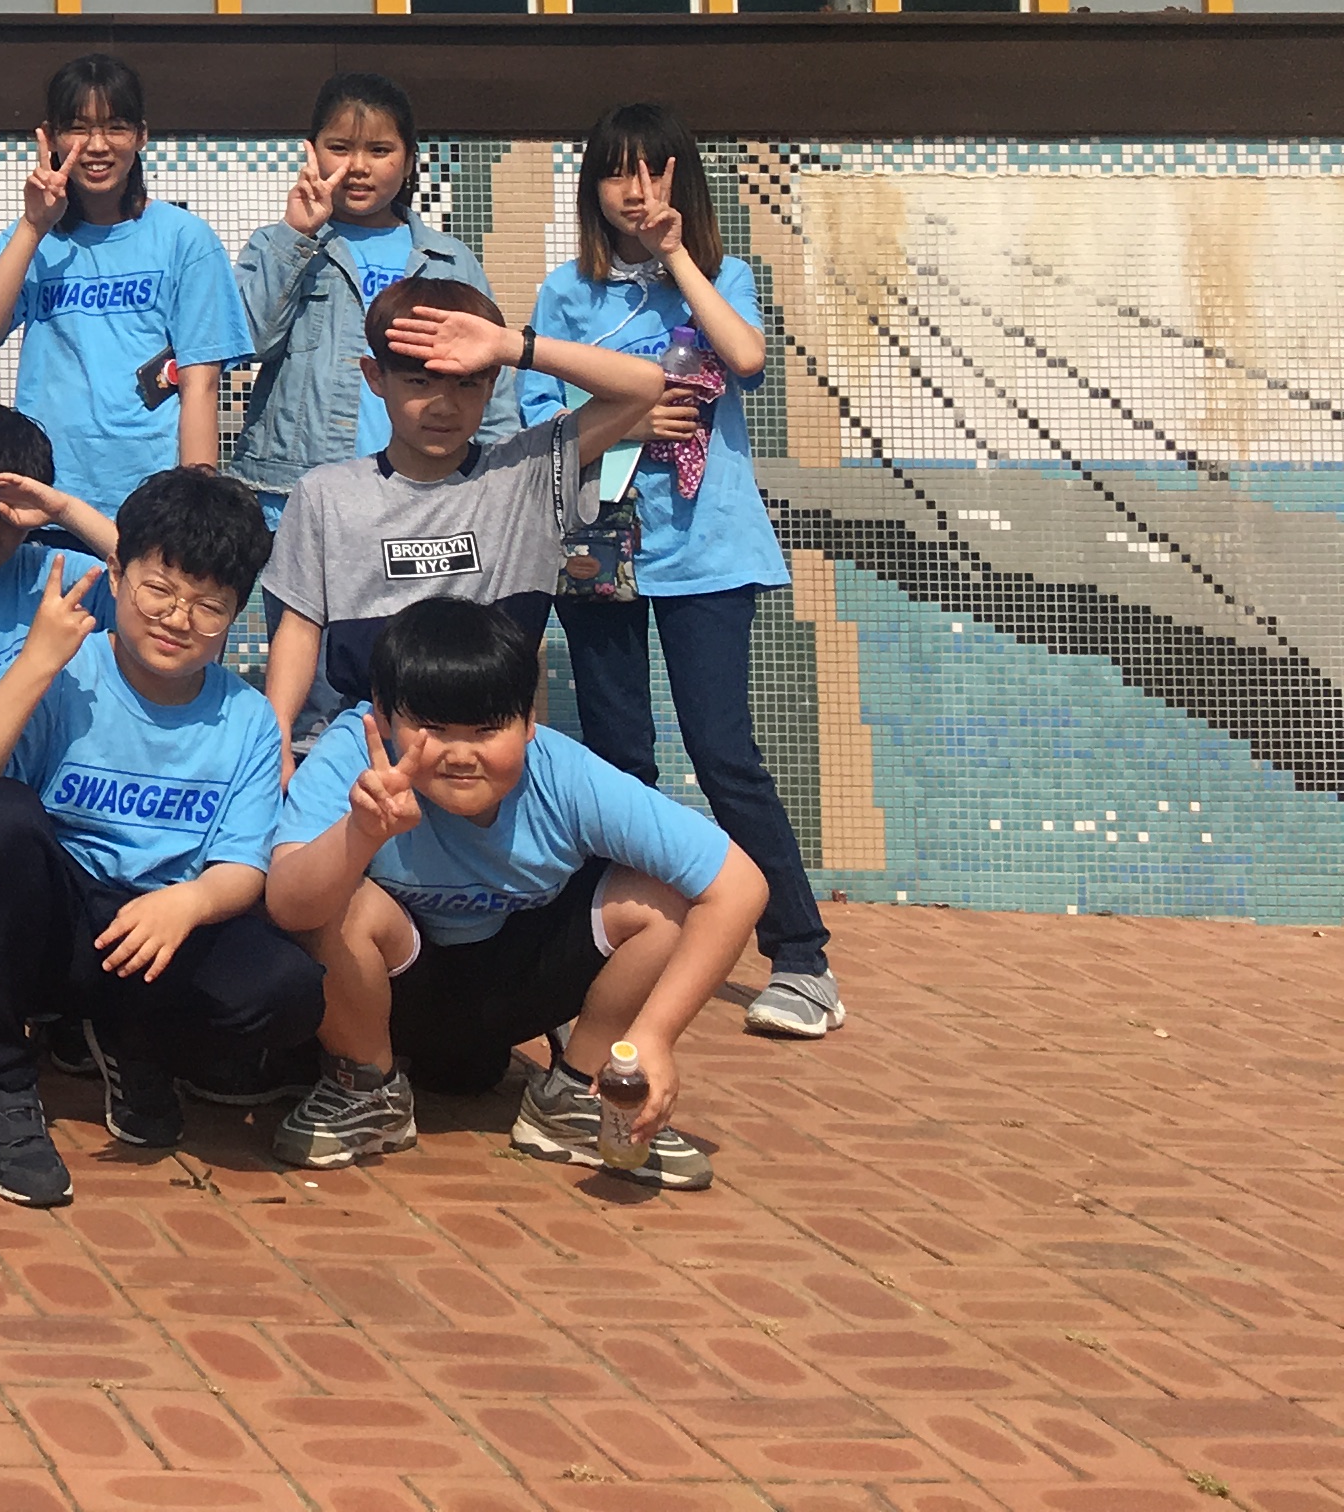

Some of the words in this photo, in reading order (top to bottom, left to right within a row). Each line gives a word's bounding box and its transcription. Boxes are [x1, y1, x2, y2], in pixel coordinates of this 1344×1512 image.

[41, 278, 153, 314] SWAGGERS
[391, 538, 469, 558] BROOKLYN
[415, 558, 451, 574] NYC
[54, 772, 220, 824] SWAGGERS
